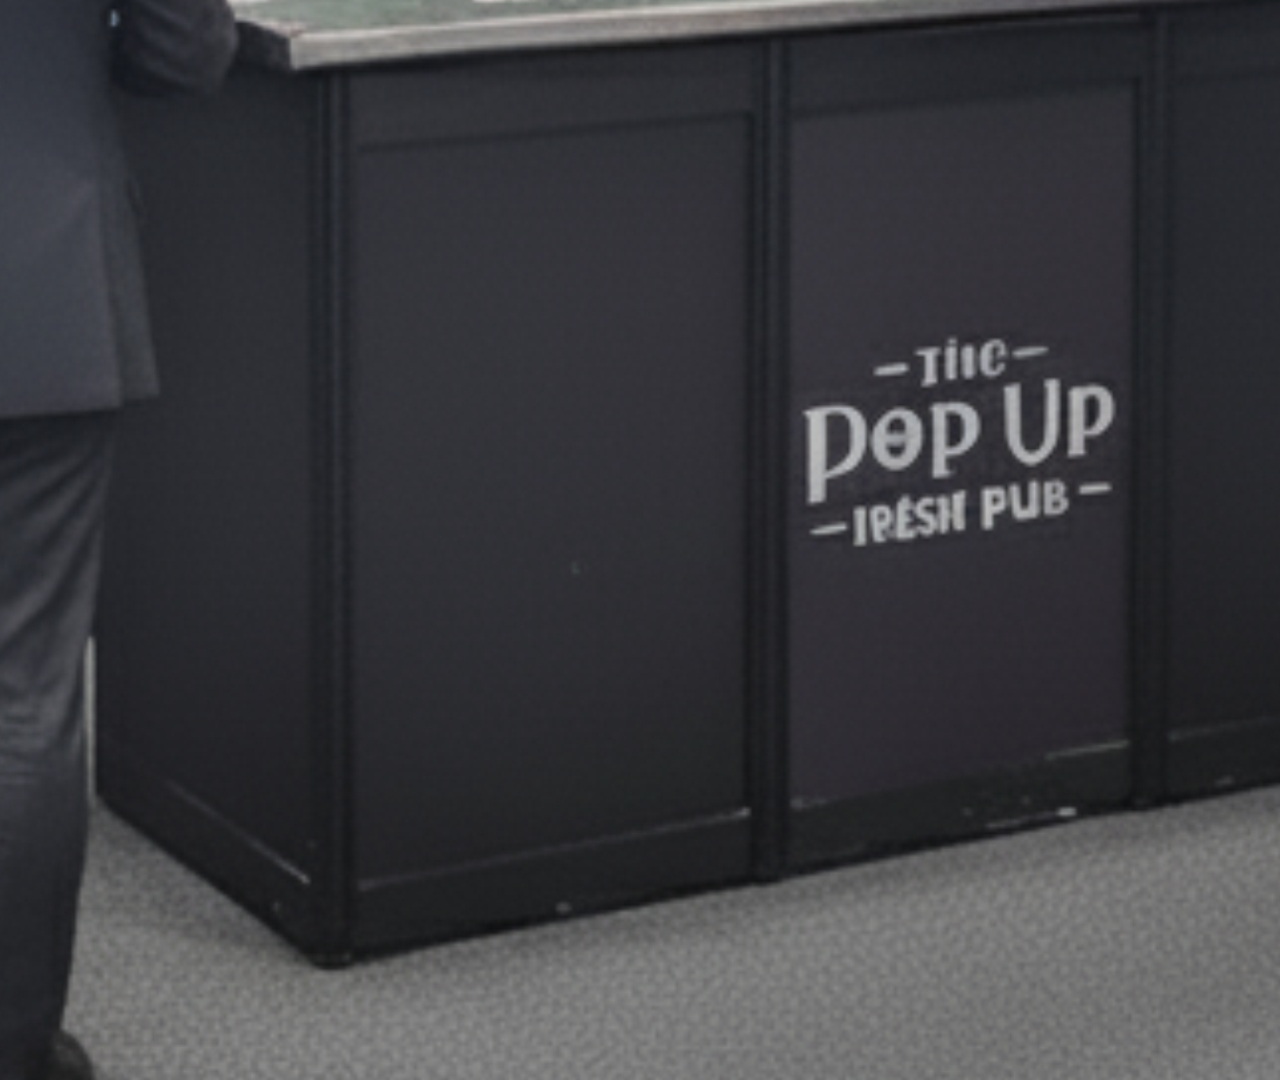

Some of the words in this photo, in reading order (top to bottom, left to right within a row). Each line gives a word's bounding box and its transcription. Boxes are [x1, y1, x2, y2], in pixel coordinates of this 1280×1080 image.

[803, 404, 981, 504] POP
[1003, 377, 1116, 466] UP
[980, 479, 1069, 531] PUB
